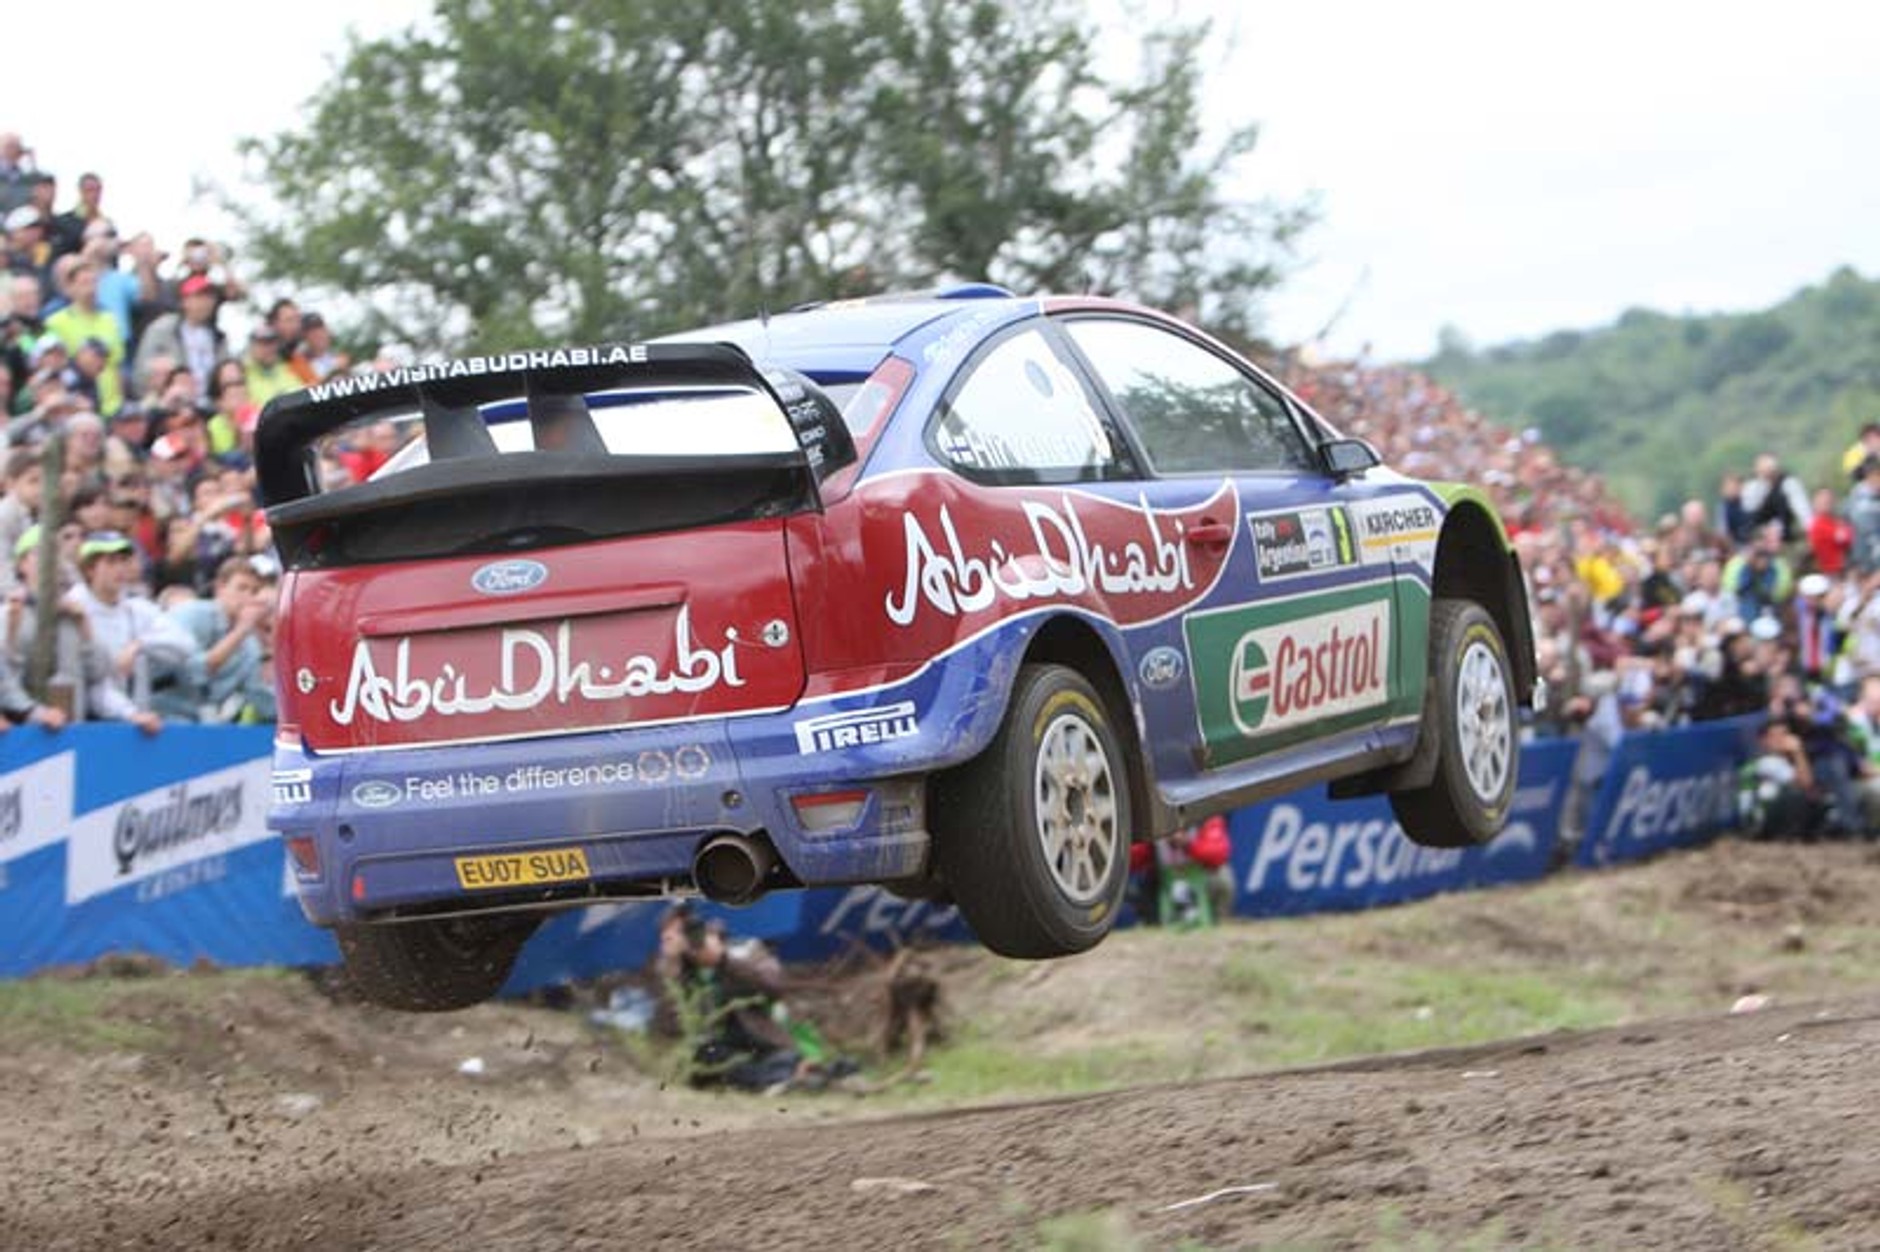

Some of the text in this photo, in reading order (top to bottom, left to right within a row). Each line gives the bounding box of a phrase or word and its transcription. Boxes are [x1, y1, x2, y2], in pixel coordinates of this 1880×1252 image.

[308, 345, 648, 402] WWW.VISITABUDHABI.AE
[1272, 617, 1380, 717] Castrol
[794, 700, 919, 756] PIRELLI
[405, 776, 453, 801] Feel
[460, 772, 499, 796] the
[505, 760, 634, 793] difference
[461, 852, 586, 884] EU07 SUA
